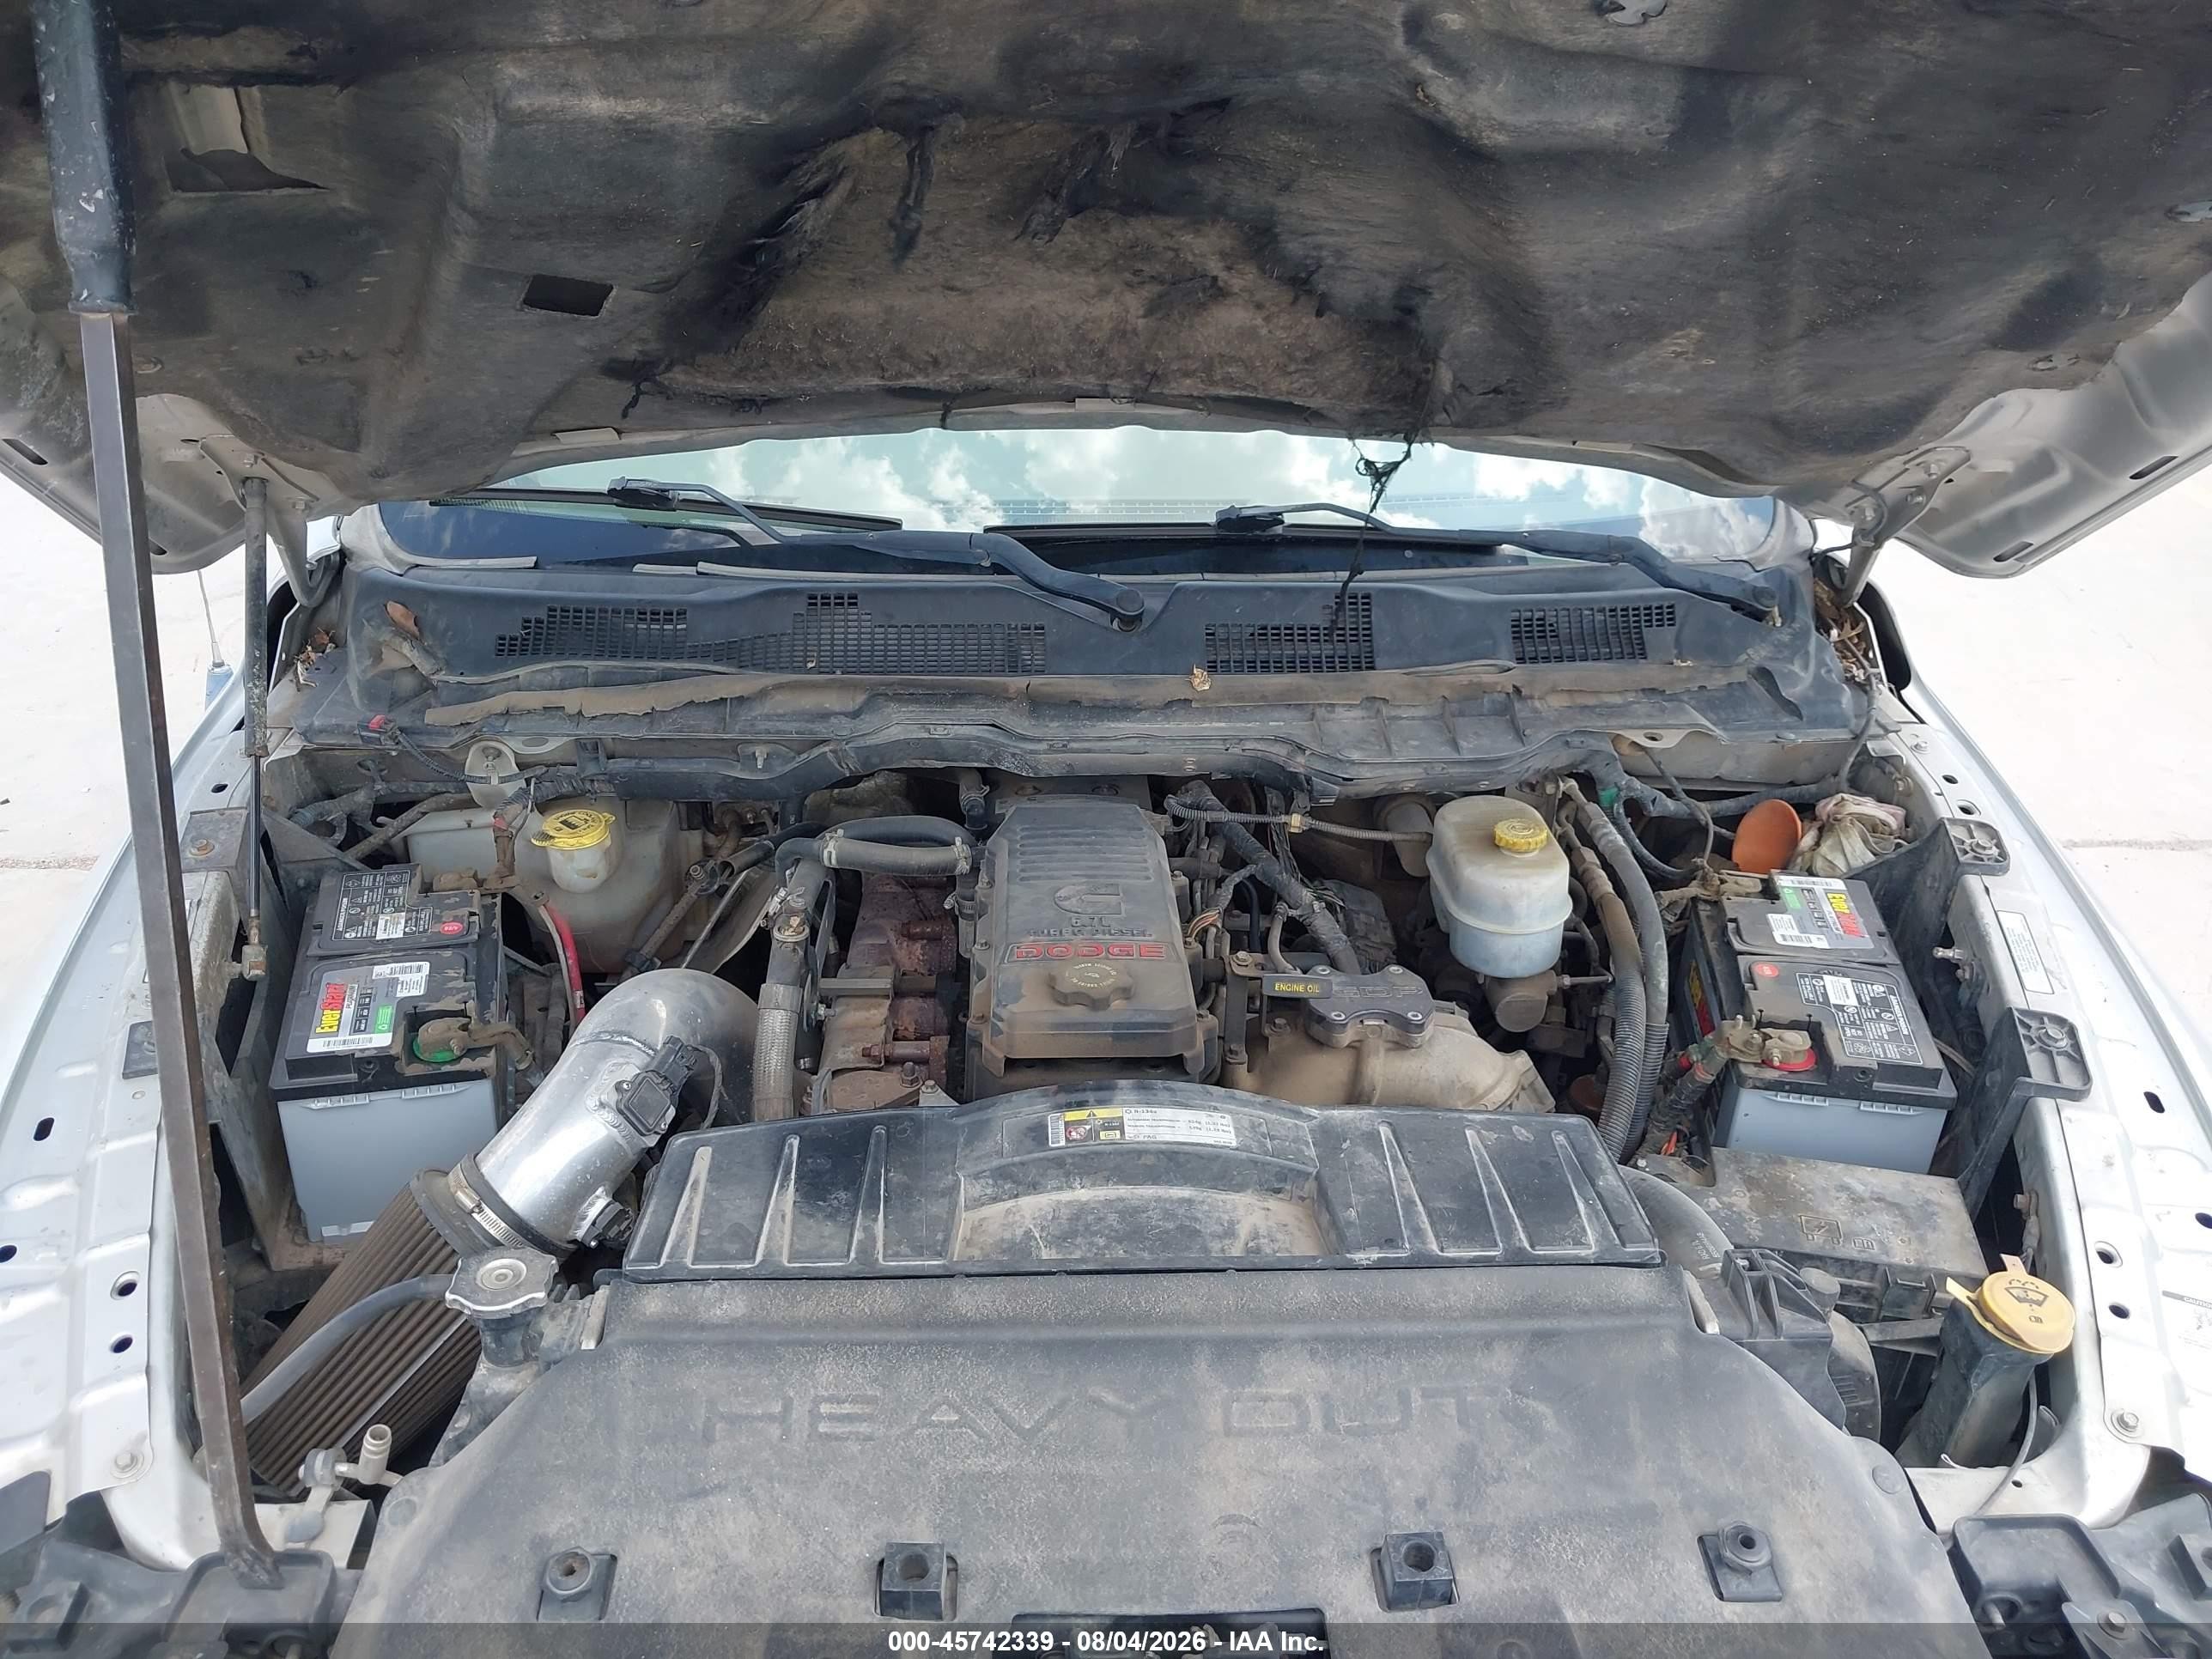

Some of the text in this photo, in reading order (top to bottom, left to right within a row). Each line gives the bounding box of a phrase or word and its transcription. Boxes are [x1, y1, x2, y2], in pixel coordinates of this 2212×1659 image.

[1091, 927, 1153, 937] DIESEL
[1015, 943, 1167, 960] DODGE
[1274, 982, 1320, 993] ENGINE OIL
[315, 981, 347, 1034] EverStart
[700, 1384, 1561, 1443] HEAVY DUTY
